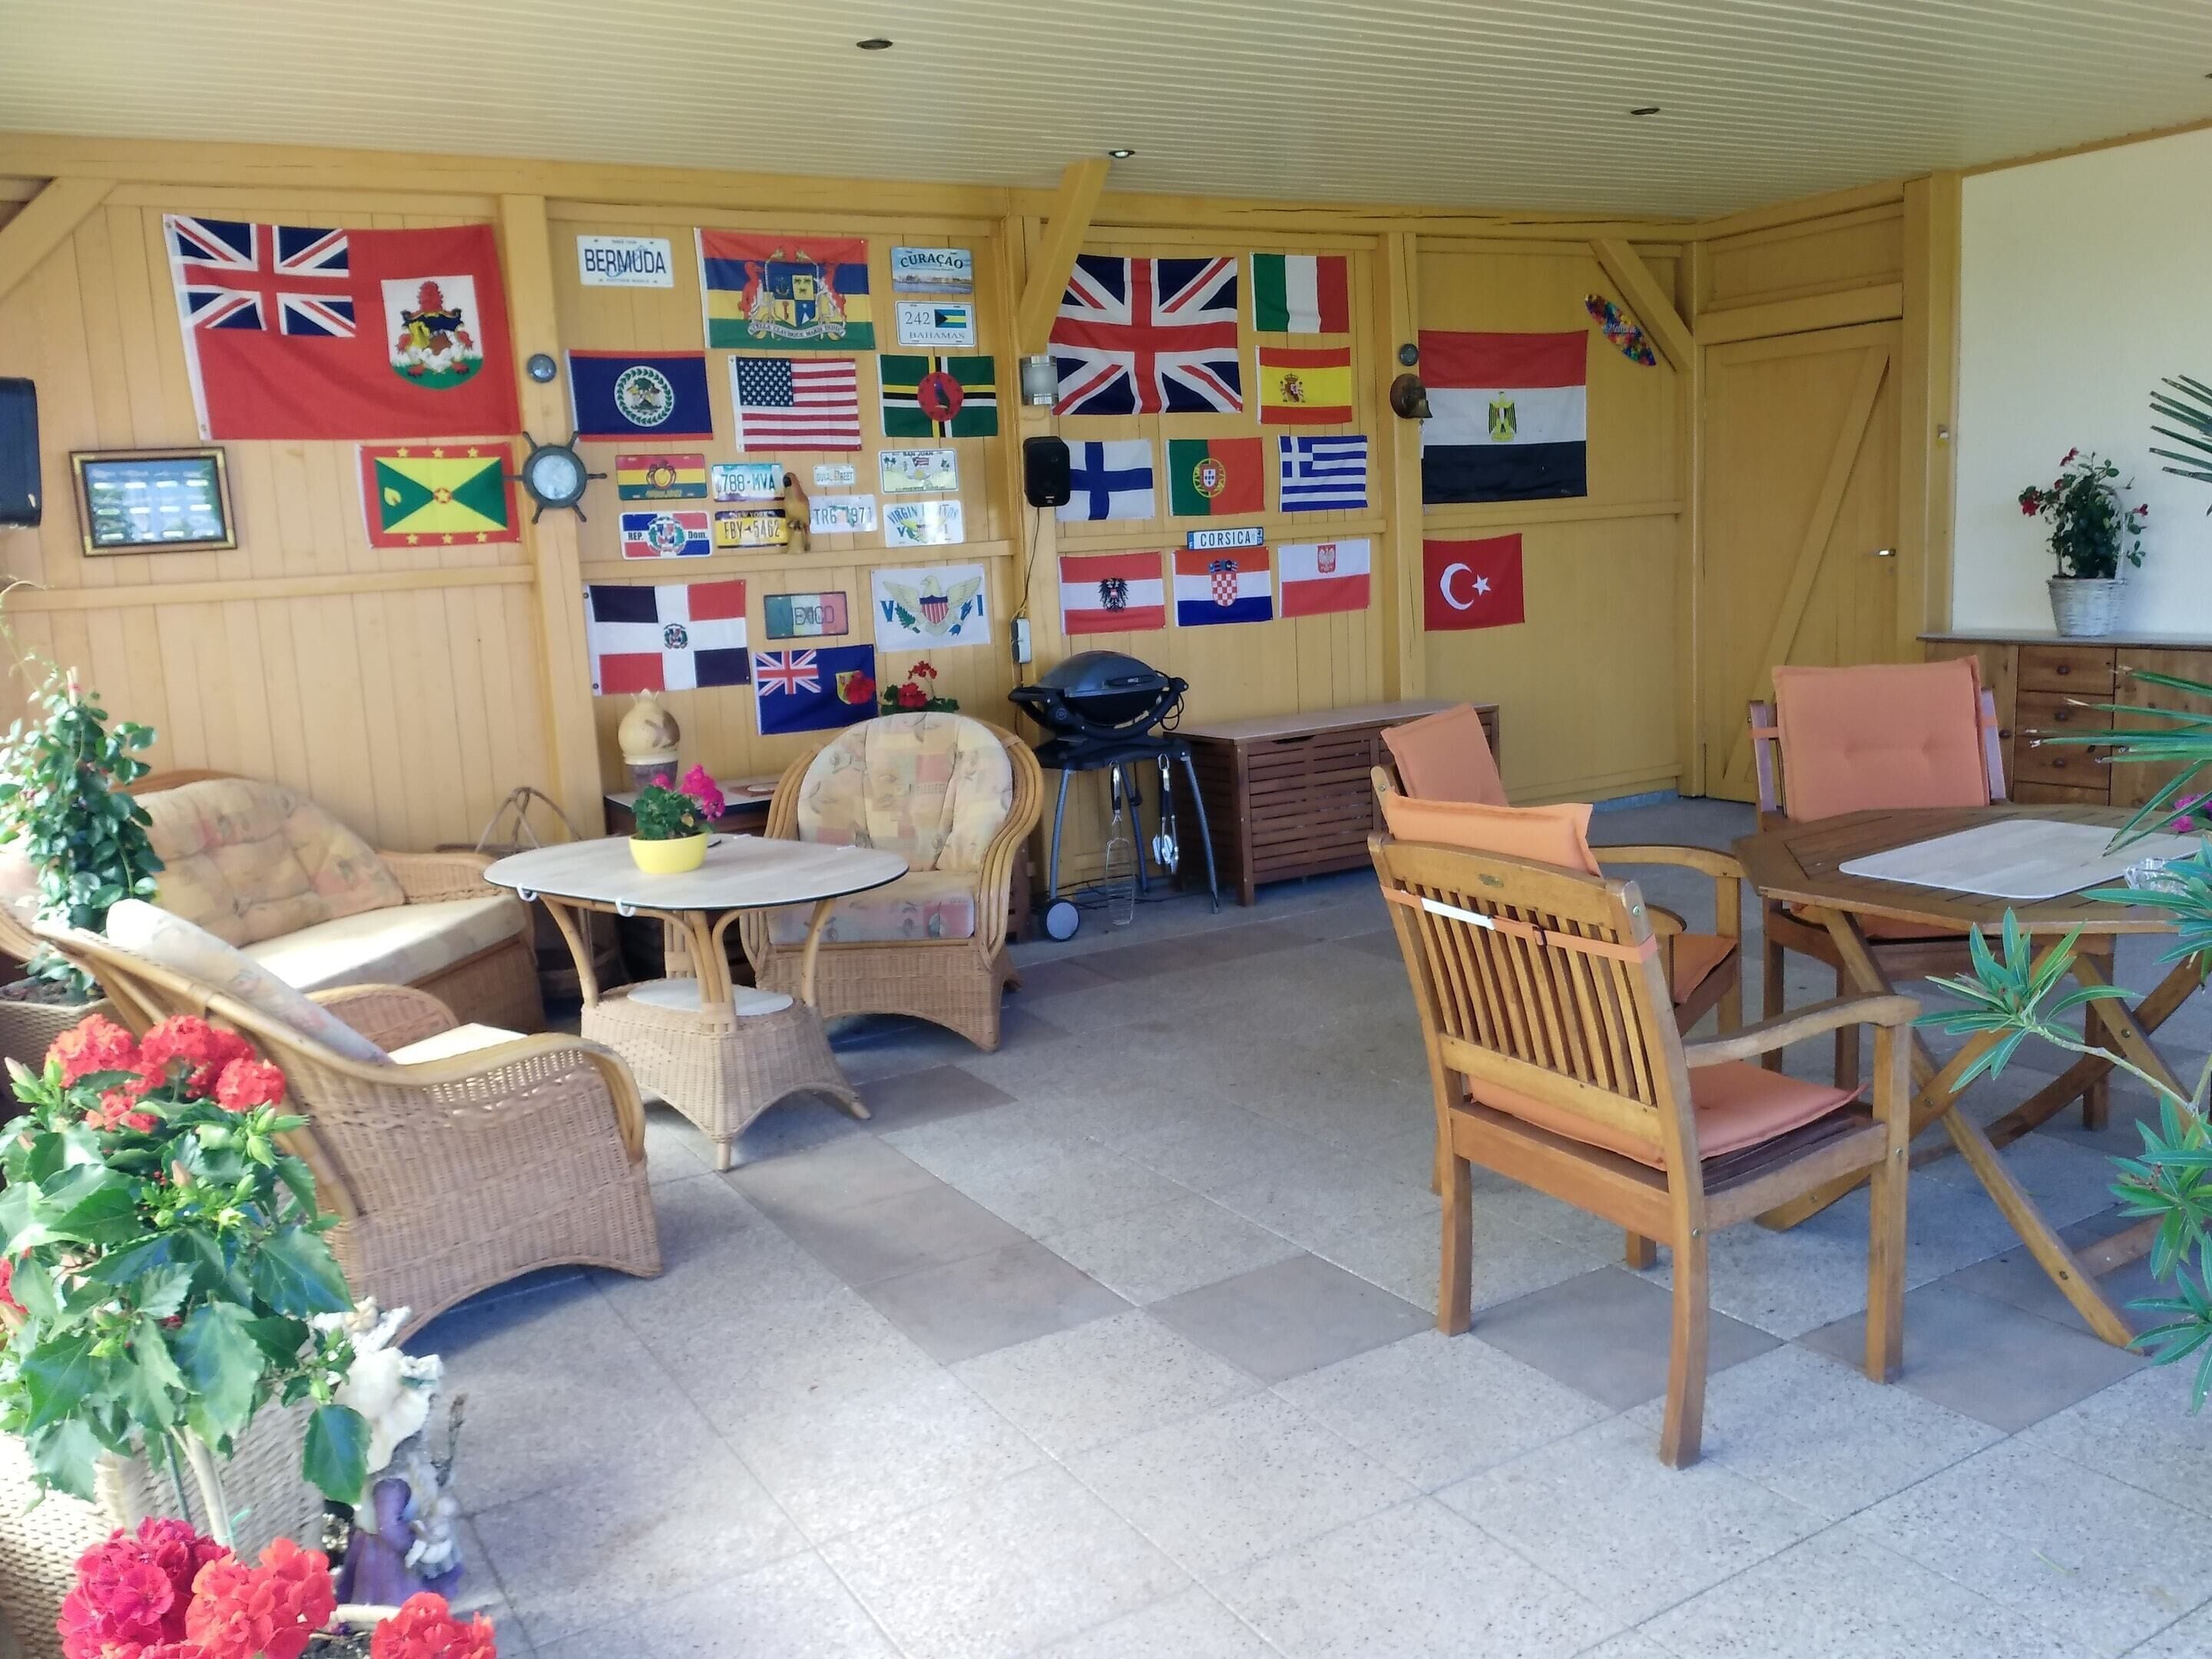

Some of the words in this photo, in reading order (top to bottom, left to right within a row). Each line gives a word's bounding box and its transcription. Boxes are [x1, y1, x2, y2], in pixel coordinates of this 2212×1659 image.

[584, 249, 666, 273] BERMUDA
[900, 253, 963, 269] CURAÇAO
[905, 311, 930, 325] 242
[887, 505, 918, 525] VIRGIN
[628, 531, 644, 541] REP.
[688, 530, 707, 539] Dom.
[724, 522, 743, 539] FBY
[753, 519, 780, 538] 5462
[1200, 531, 1251, 547] CORSICA
[793, 605, 835, 626] EXICO
[880, 600, 895, 622] V
